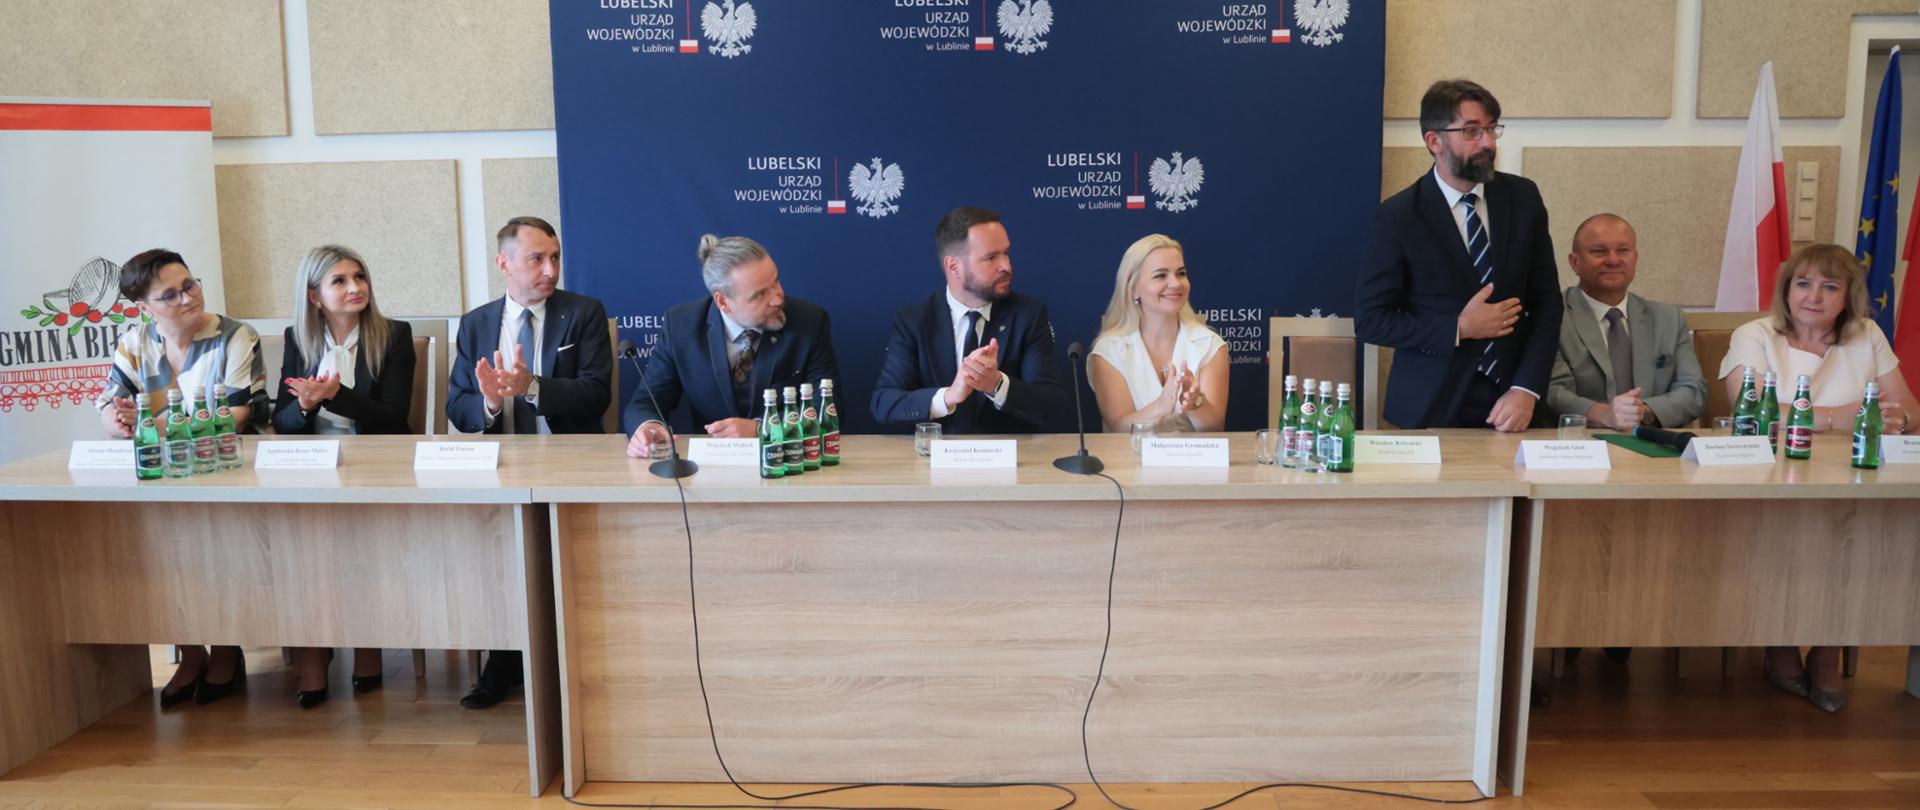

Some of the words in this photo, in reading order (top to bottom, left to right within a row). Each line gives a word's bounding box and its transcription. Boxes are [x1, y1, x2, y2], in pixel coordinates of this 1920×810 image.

[1222, 5, 1267, 18] URZĄD
[630, 14, 674, 27] URZĄD
[925, 12, 969, 25] URZĄD
[880, 25, 969, 39] WOJEWÓDZKI
[1177, 18, 1267, 33] WOJEWÓDZKI
[586, 28, 675, 41] WOJEWÓDZKI
[1233, 35, 1267, 44] Lublinie
[642, 43, 675, 53] Lublinie
[936, 42, 970, 51] Lublinie
[747, 156, 821, 170] LUBELSKI
[1047, 152, 1121, 167] LUBELSKI
[778, 175, 822, 188] URZĄD
[1077, 171, 1121, 184] URZĄD
[734, 188, 822, 201] WOJEWÓDZKI
[1032, 184, 1121, 199] WOJEWÓDZKI
[779, 206, 787, 214] w
[789, 204, 823, 214] Lublinie
[1088, 201, 1122, 210] Lublinie
[1198, 308, 1262, 322] UBELSKI
[1219, 326, 1262, 339] URZĄD
[0, 328, 79, 367] GMINA
